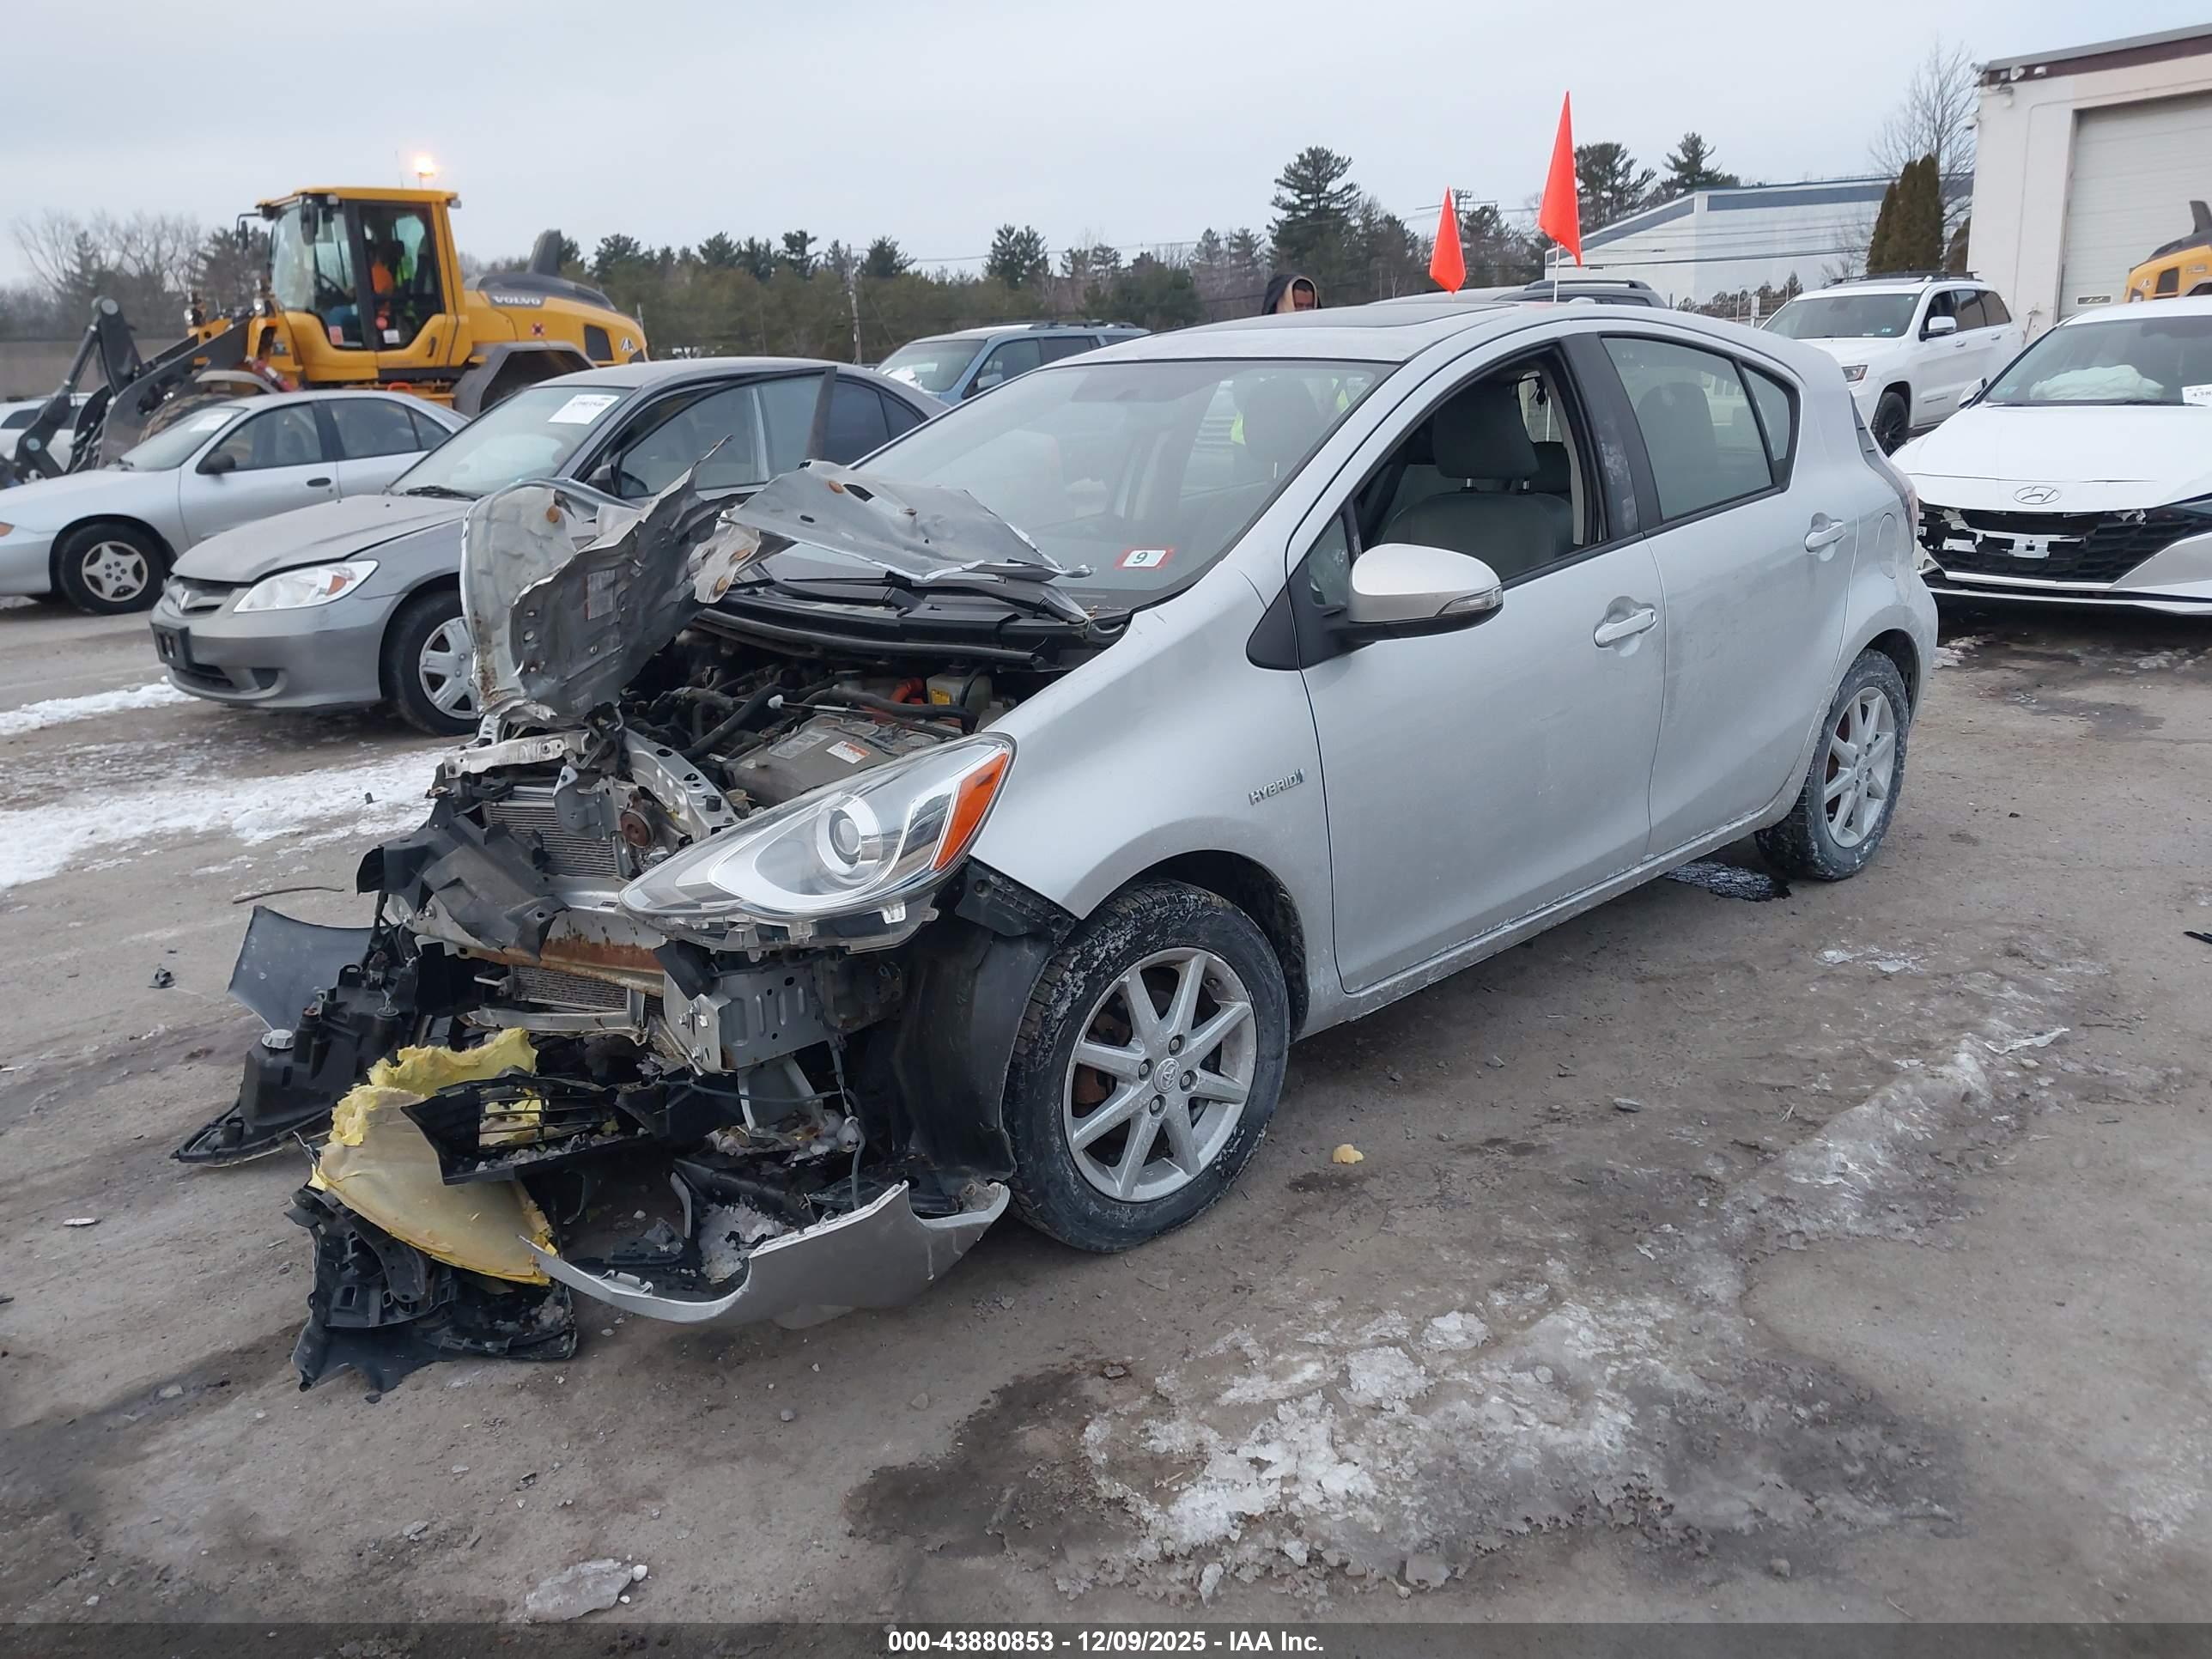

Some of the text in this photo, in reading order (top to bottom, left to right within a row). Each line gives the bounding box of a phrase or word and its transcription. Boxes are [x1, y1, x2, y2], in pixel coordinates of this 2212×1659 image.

[492, 295, 541, 306] VOLVO
[1133, 551, 1148, 564] 9
[1249, 773, 1299, 805] HYBRID
